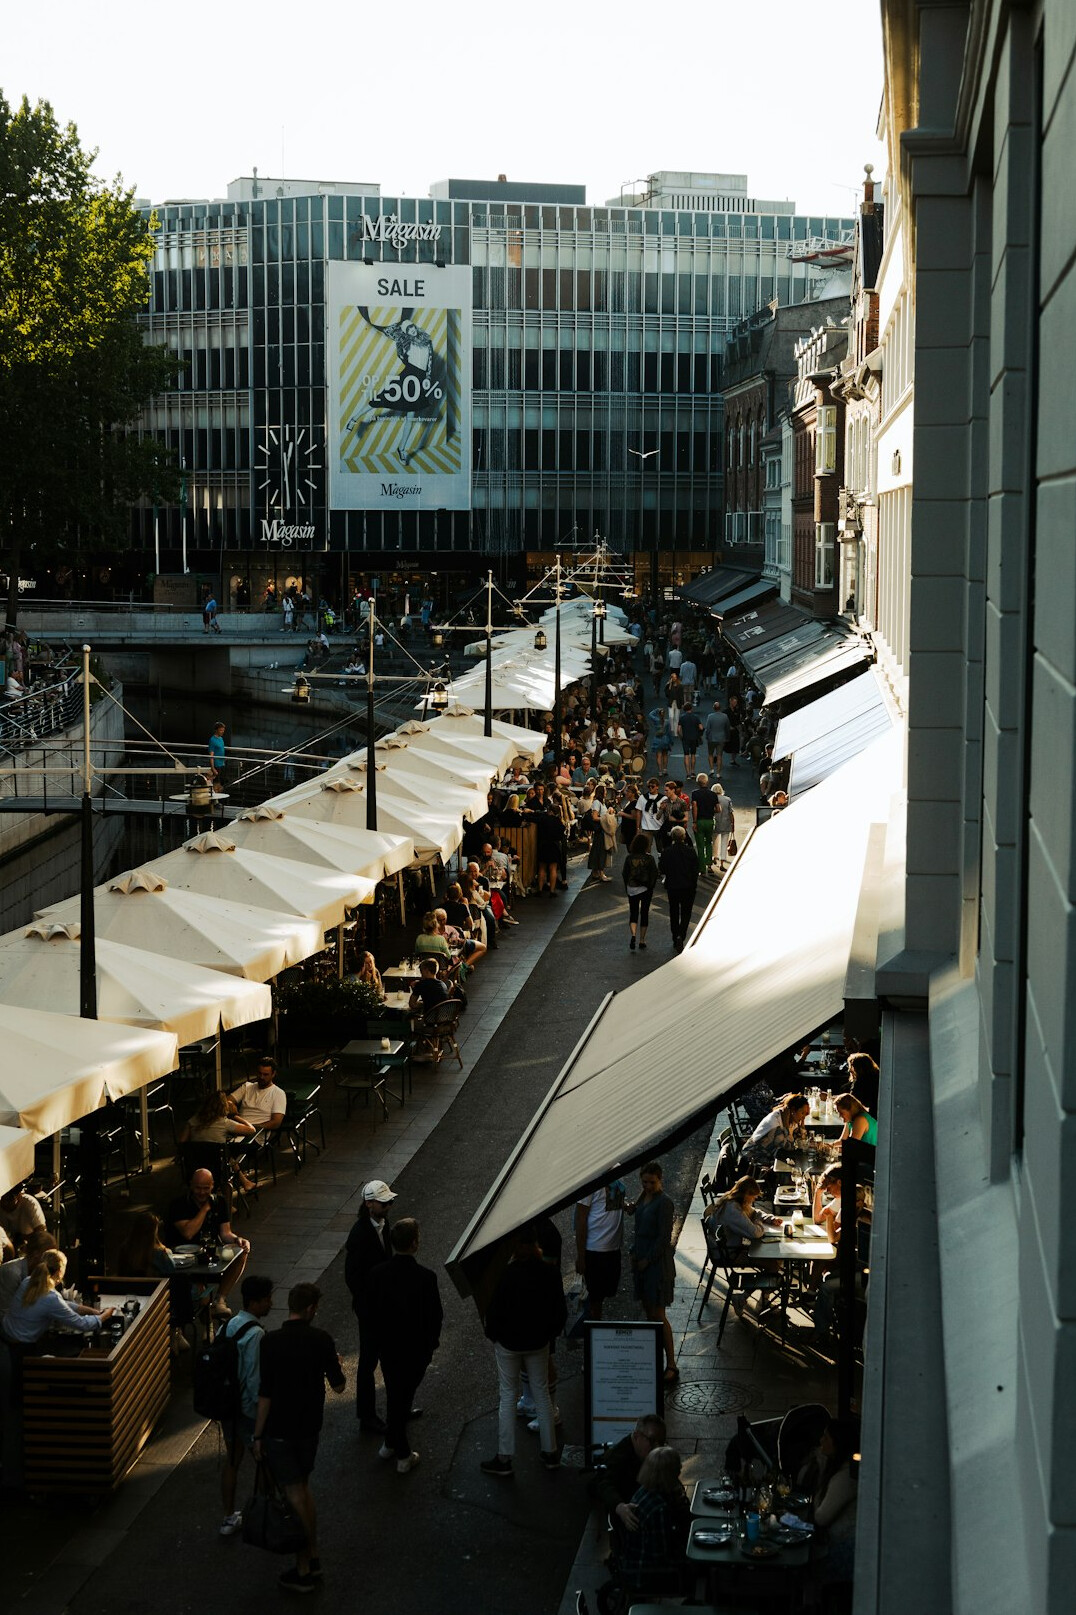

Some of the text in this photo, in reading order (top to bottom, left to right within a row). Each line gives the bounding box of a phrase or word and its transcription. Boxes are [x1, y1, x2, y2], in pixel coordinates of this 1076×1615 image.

[360, 213, 442, 249] Magasin
[377, 278, 426, 298] SALE
[362, 374, 379, 388] OP
[384, 375, 442, 402] 50%
[361, 390, 381, 402] TIL
[381, 483, 422, 499] Magasin
[260, 518, 316, 547] Magasin
